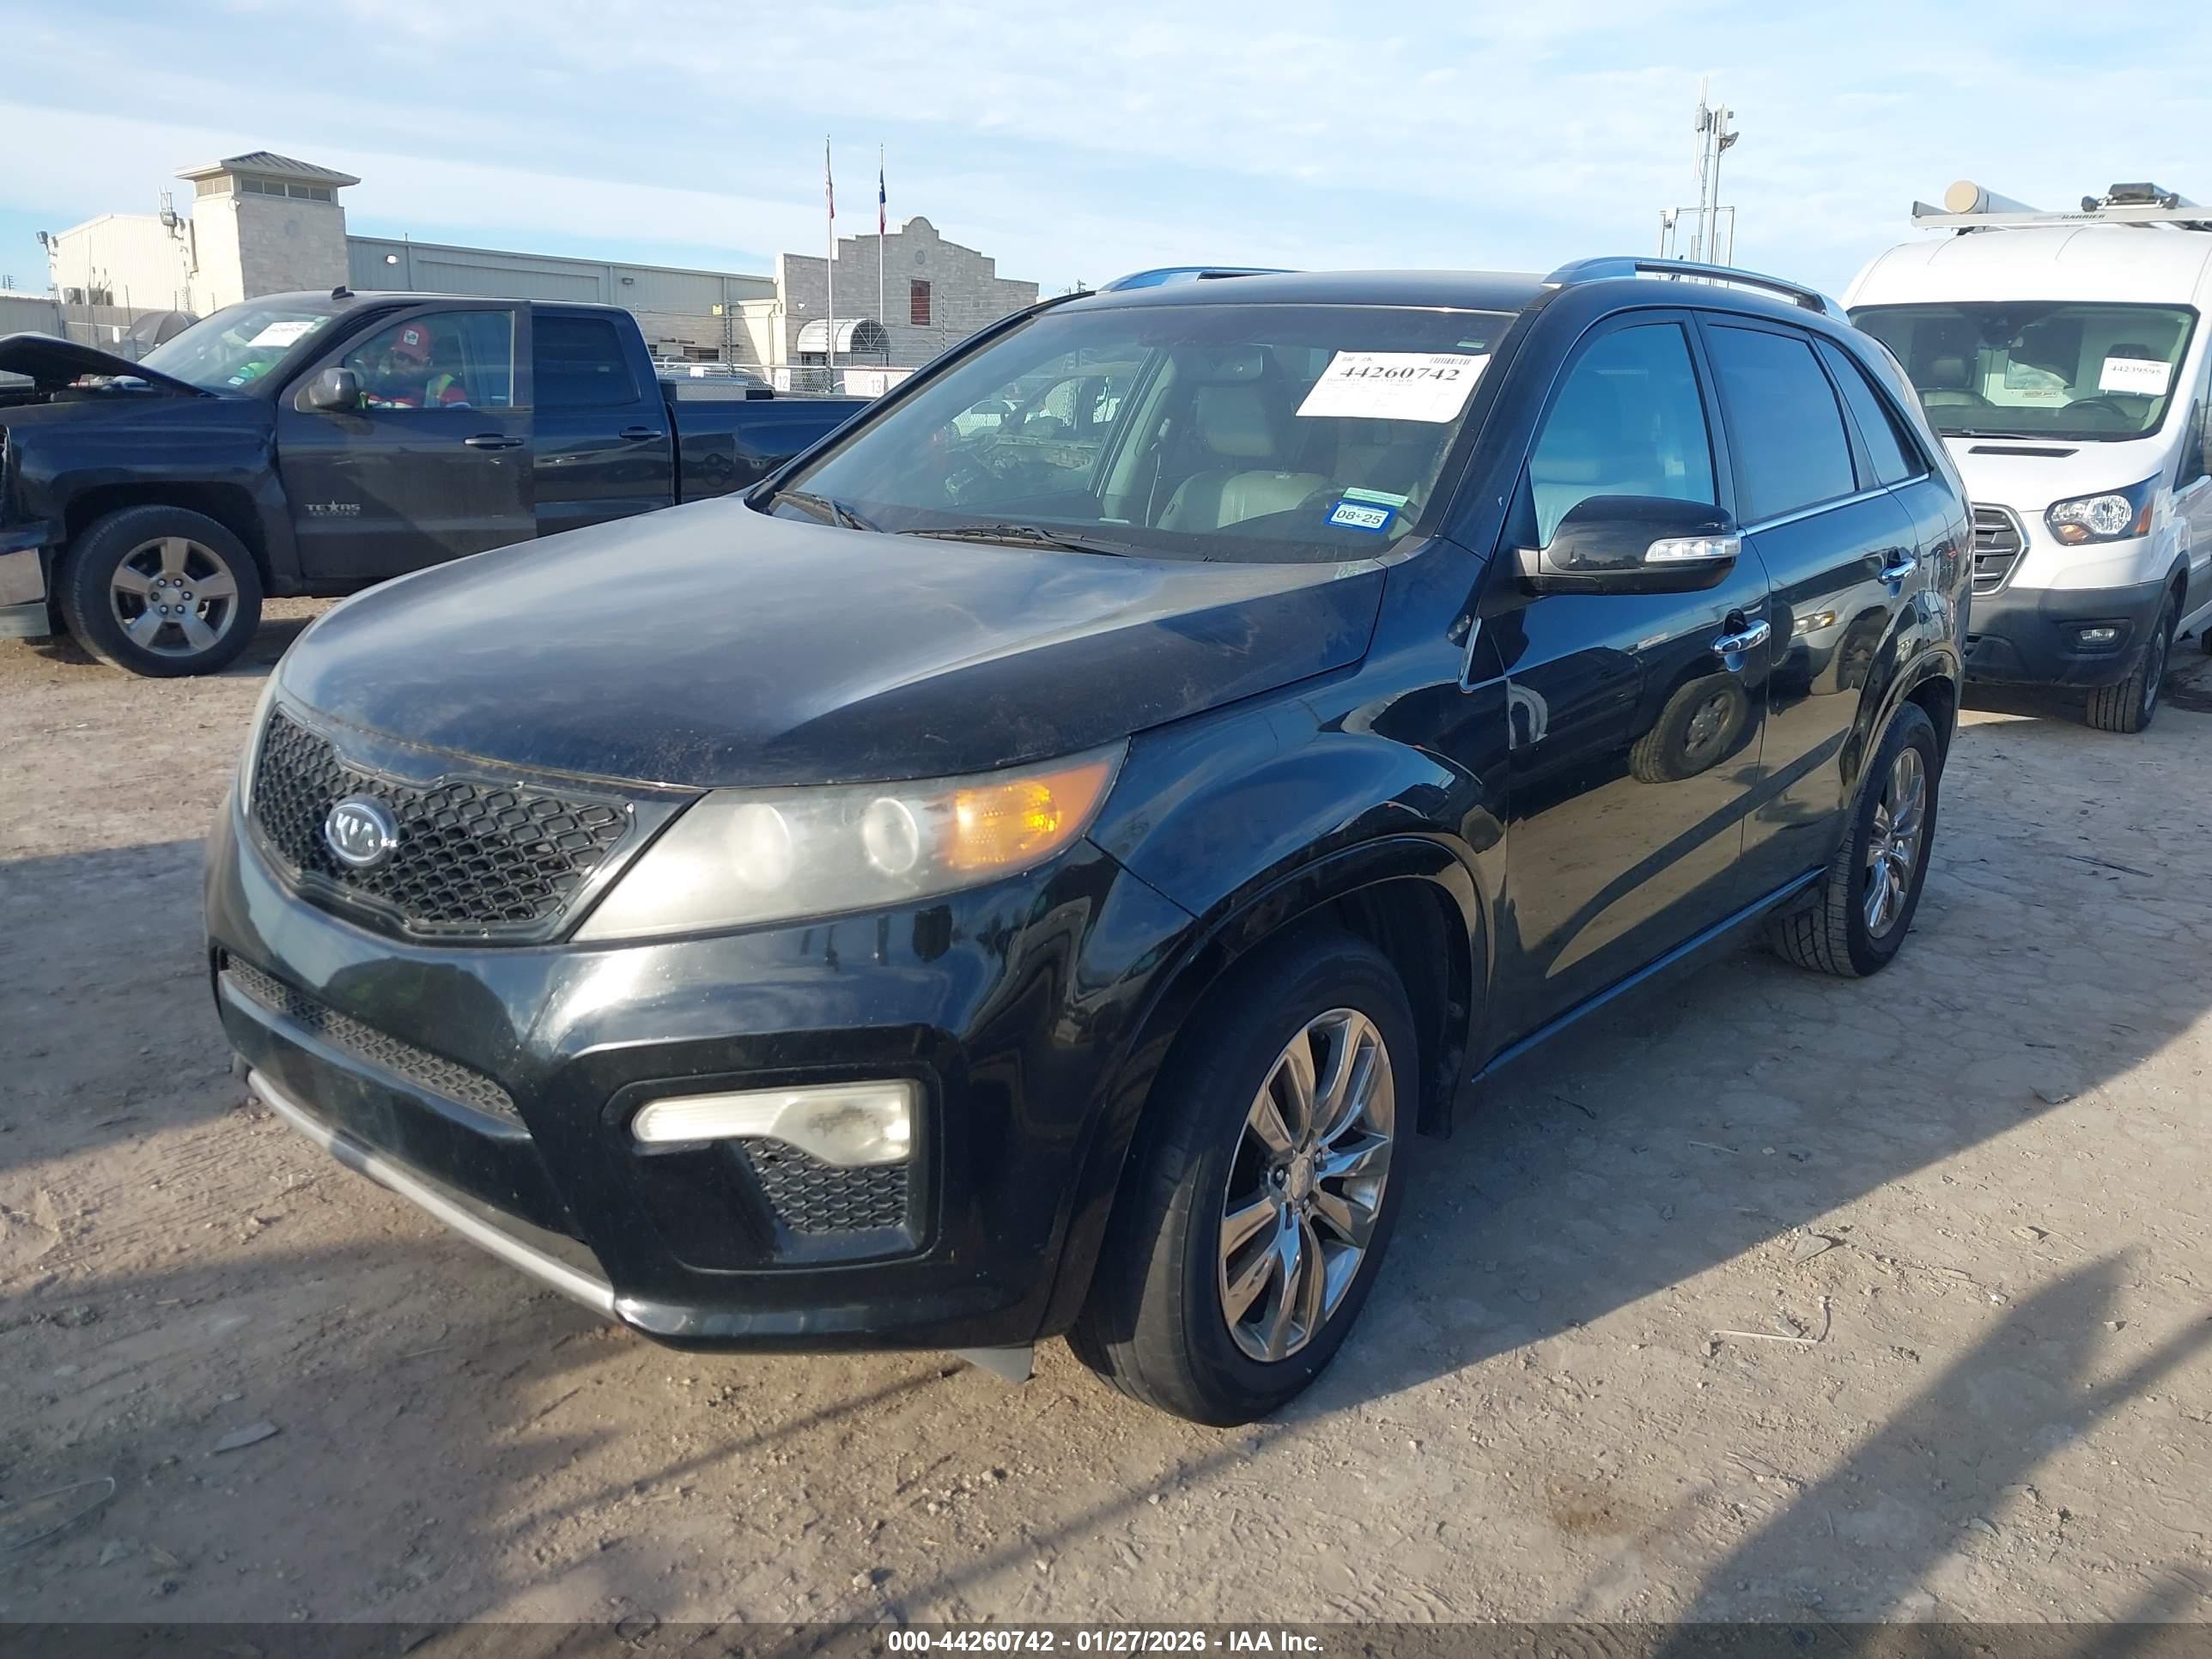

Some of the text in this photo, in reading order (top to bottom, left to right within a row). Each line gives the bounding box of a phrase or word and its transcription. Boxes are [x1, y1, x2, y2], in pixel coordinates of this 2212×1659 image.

[1340, 366, 1461, 381] 44260742
[777, 375, 789, 389] 12
[871, 380, 882, 394] 13
[1336, 509, 1357, 520] 08
[1361, 514, 1383, 525] 25
[336, 812, 375, 849] KIA
